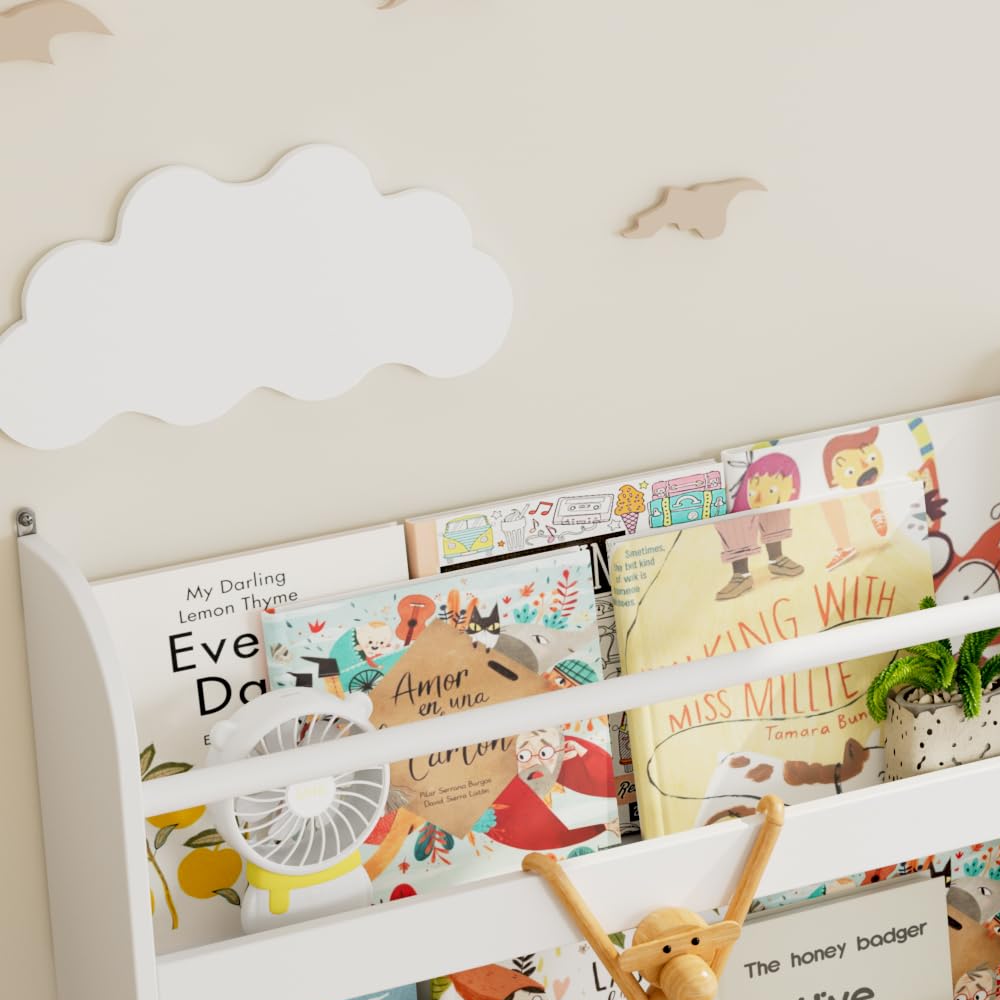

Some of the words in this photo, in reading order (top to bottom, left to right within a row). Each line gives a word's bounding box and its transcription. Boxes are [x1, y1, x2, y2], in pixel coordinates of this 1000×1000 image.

[186, 586, 213, 602] My
[220, 571, 286, 595] Darling
[814, 576, 896, 627] WITH
[179, 604, 235, 624] Lemon
[241, 591, 299, 611] Thyme
[168, 631, 260, 673] Eve
[392, 669, 469, 705] Amor
[449, 691, 490, 710] una
[668, 689, 733, 733] MISS
[743, 661, 860, 718] MILLIE
[765, 723, 832, 741] Tamara
[744, 960, 781, 979] The
[790, 942, 847, 968] honey
[856, 922, 928, 951] badger
